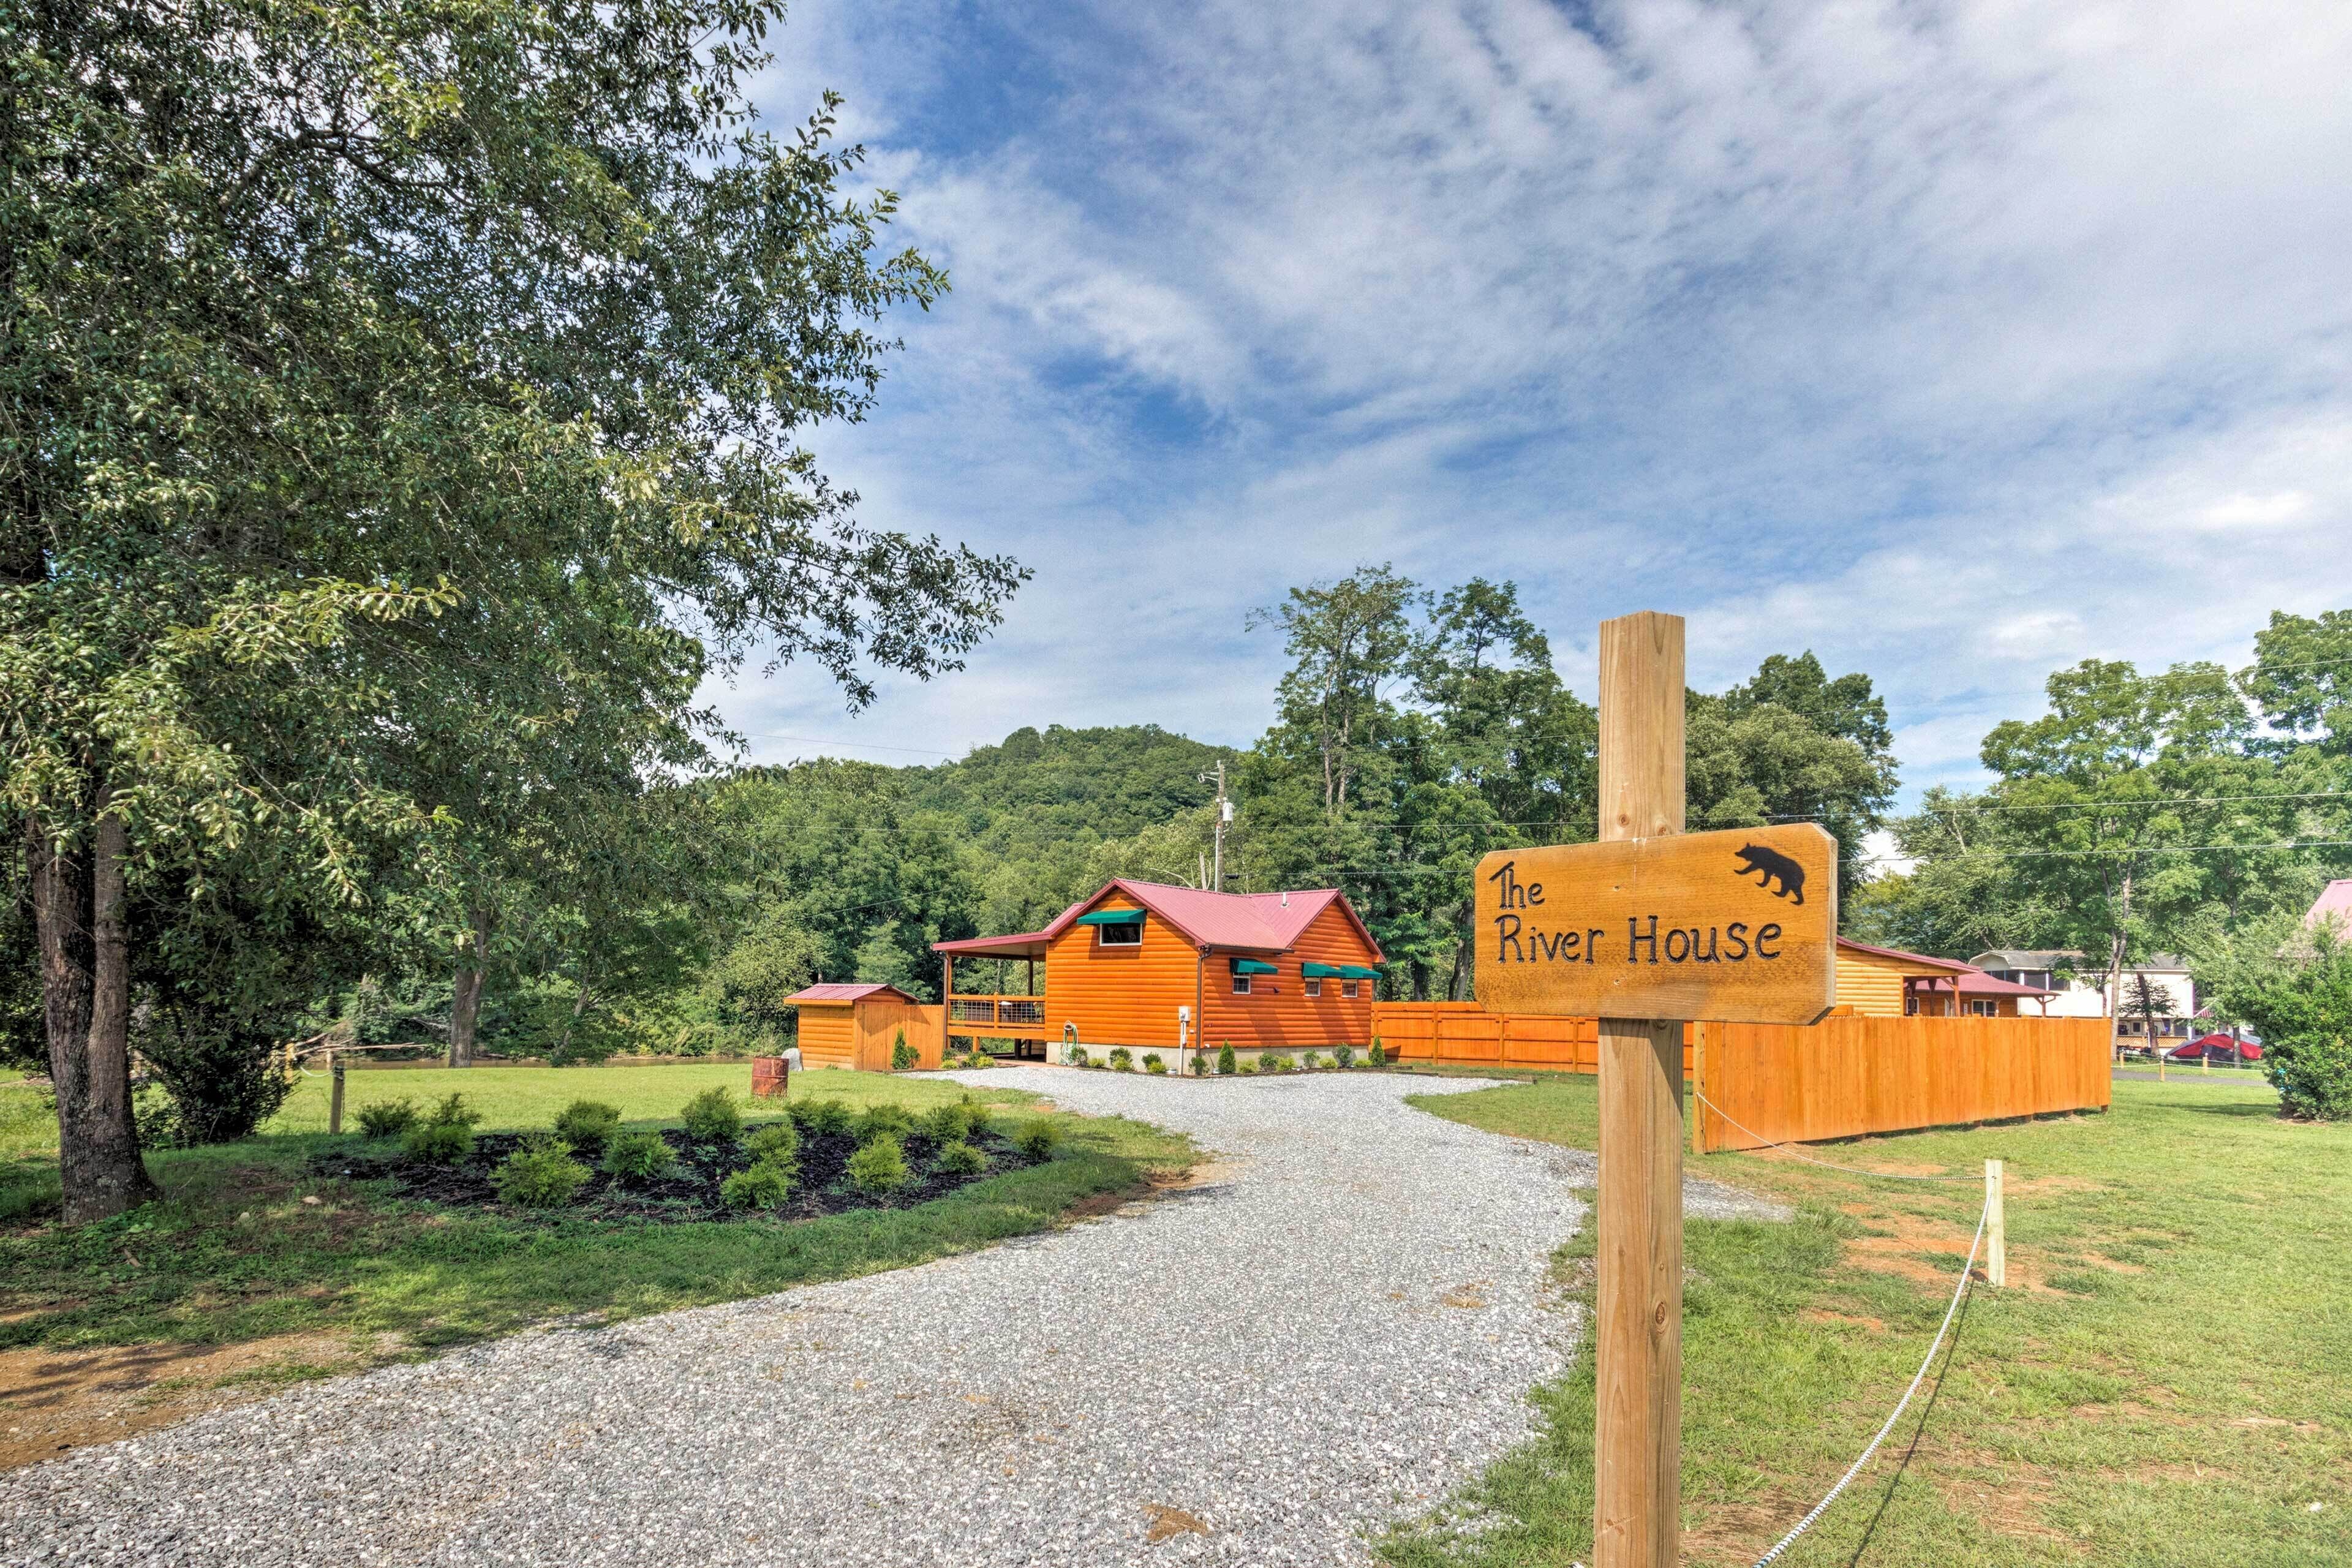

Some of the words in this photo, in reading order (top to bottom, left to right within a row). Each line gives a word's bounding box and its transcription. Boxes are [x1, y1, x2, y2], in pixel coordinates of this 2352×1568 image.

[1489, 861, 1545, 910] The
[1494, 914, 1604, 965] River
[1628, 915, 1782, 965] House
